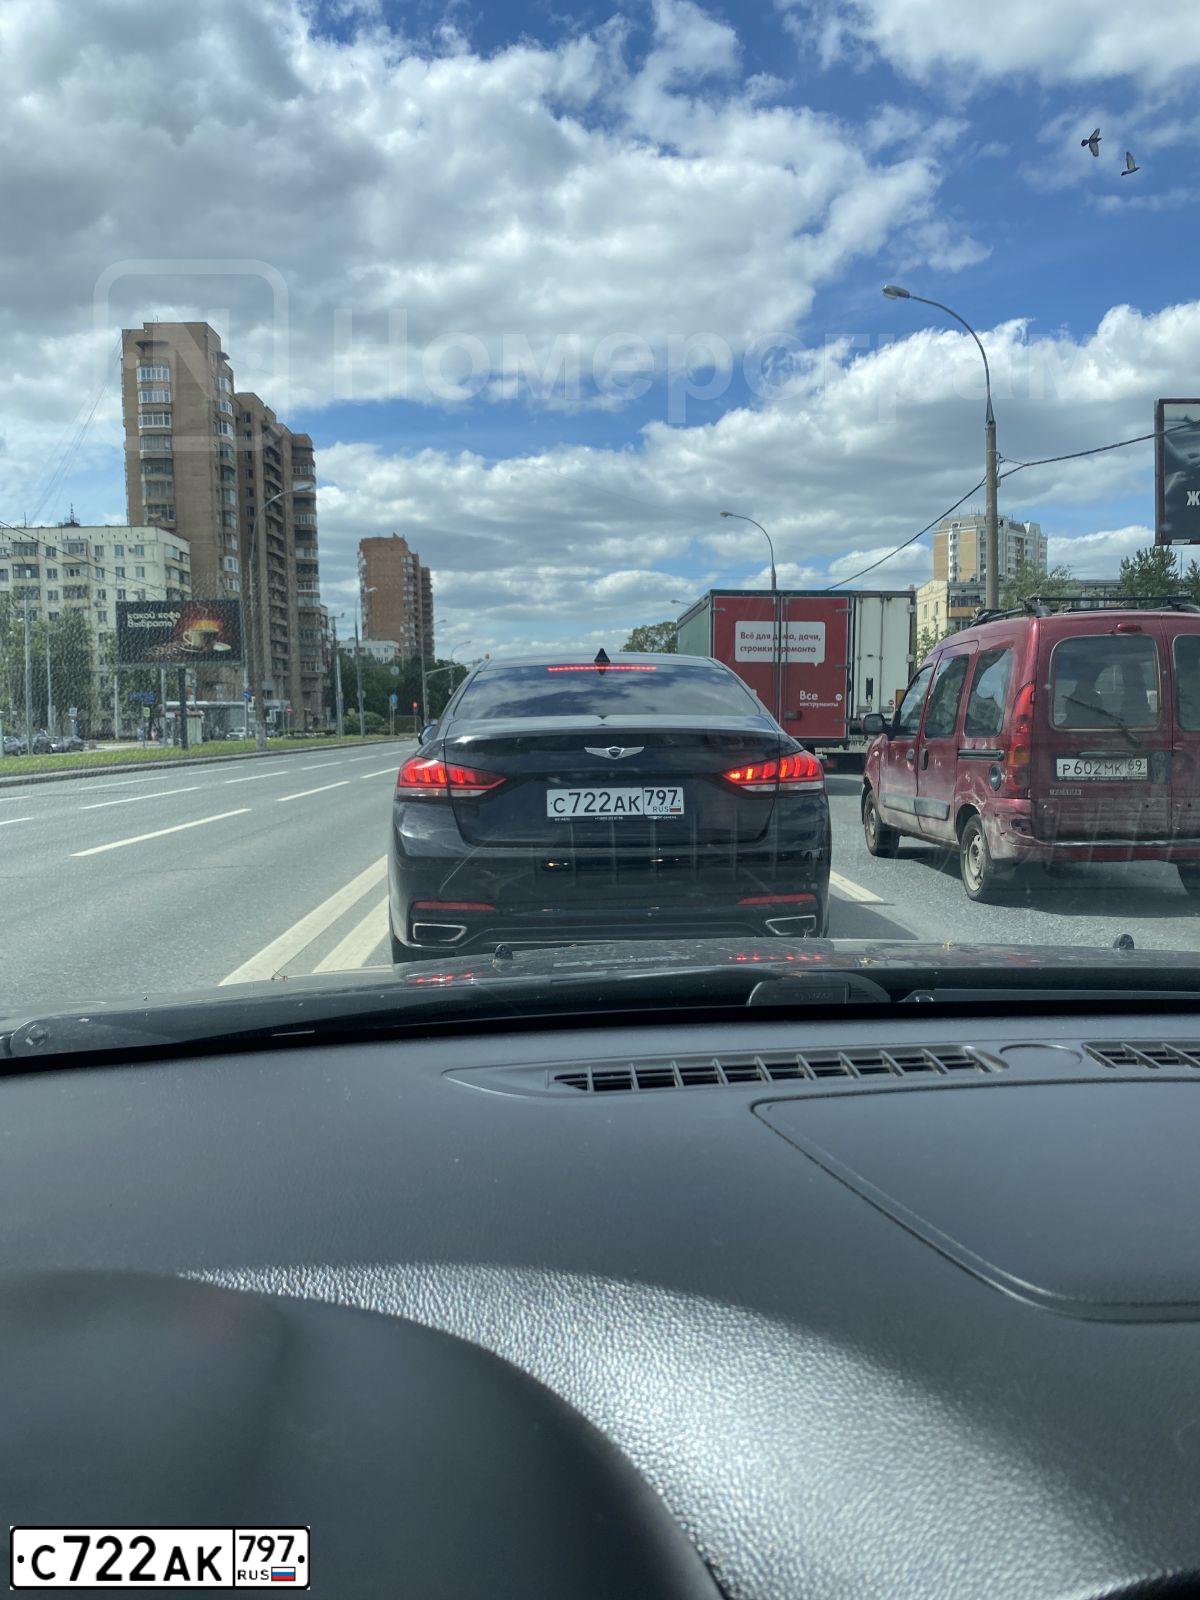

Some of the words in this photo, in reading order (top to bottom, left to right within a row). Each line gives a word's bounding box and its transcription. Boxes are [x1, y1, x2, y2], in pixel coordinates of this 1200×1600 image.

[755, 632, 771, 641] для
[799, 690, 818, 701] Все
[1062, 760, 1122, 775] Р602МК
[1127, 759, 1142, 772] 69
[553, 792, 640, 814] С722АК
[644, 789, 678, 806] 797
